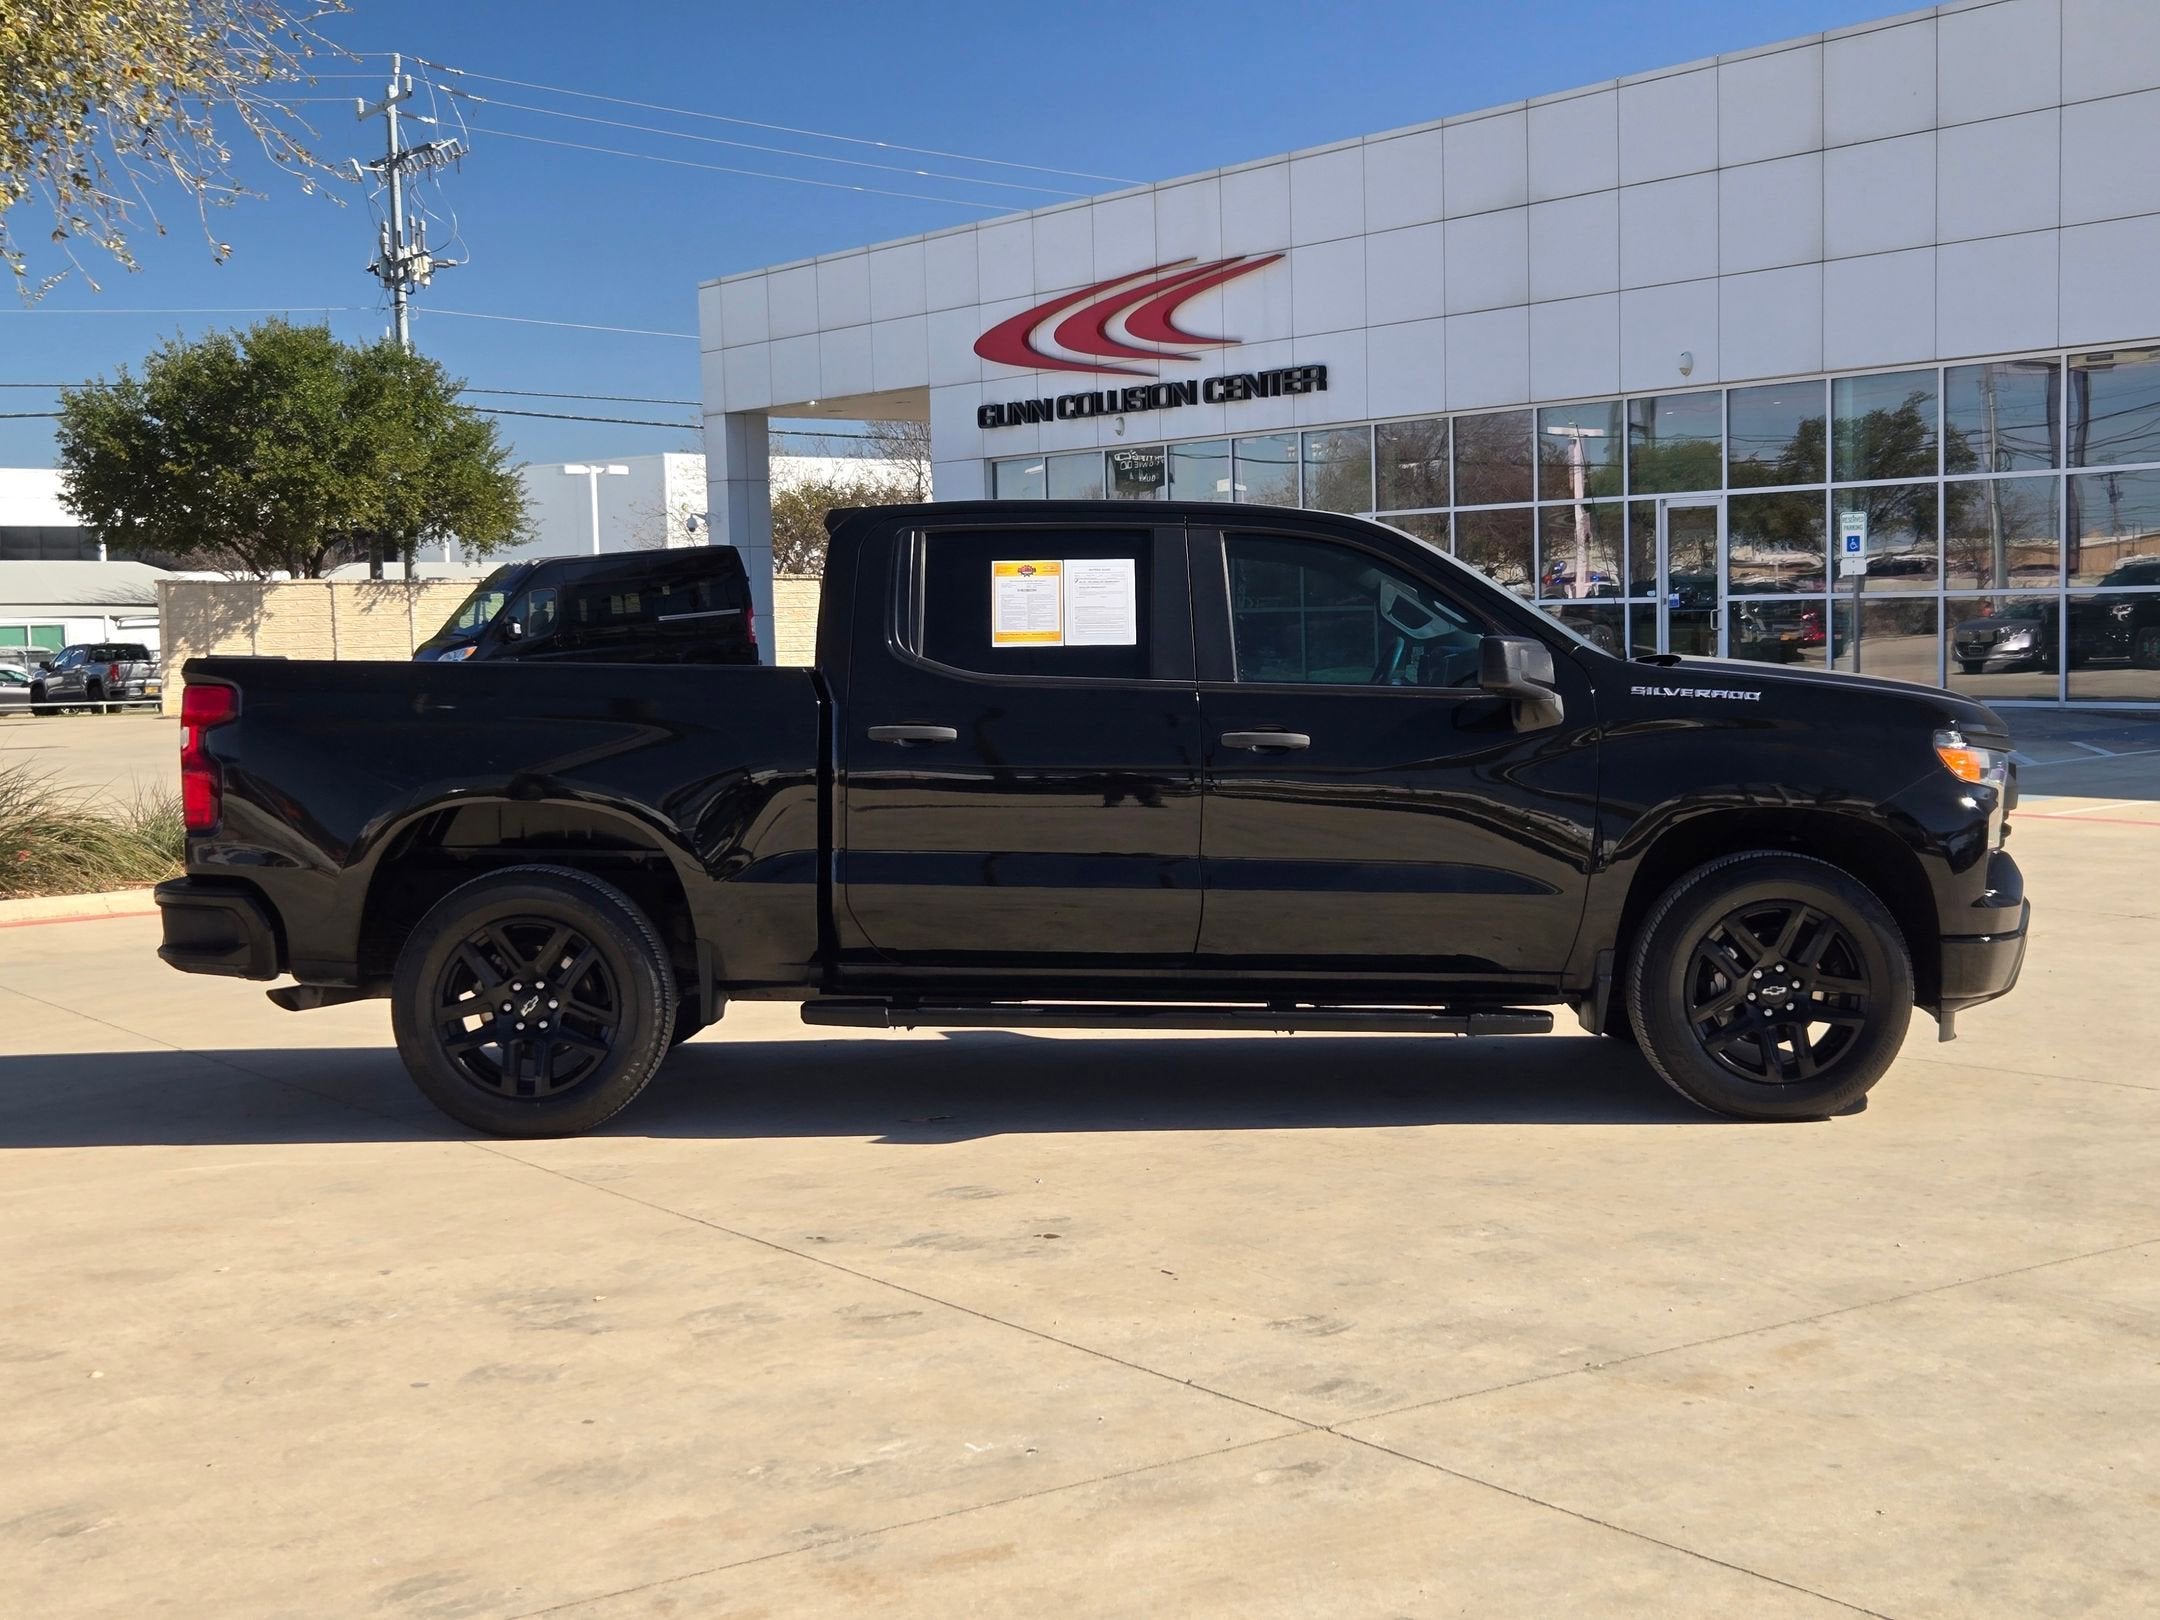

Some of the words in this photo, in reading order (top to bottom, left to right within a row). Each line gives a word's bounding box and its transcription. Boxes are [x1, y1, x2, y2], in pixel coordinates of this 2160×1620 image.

[977, 398, 1054, 429] GUNN
[1056, 380, 1199, 420] COLLISION
[1203, 364, 1328, 404] CENTER
[1630, 686, 1762, 702] SILVERADO
